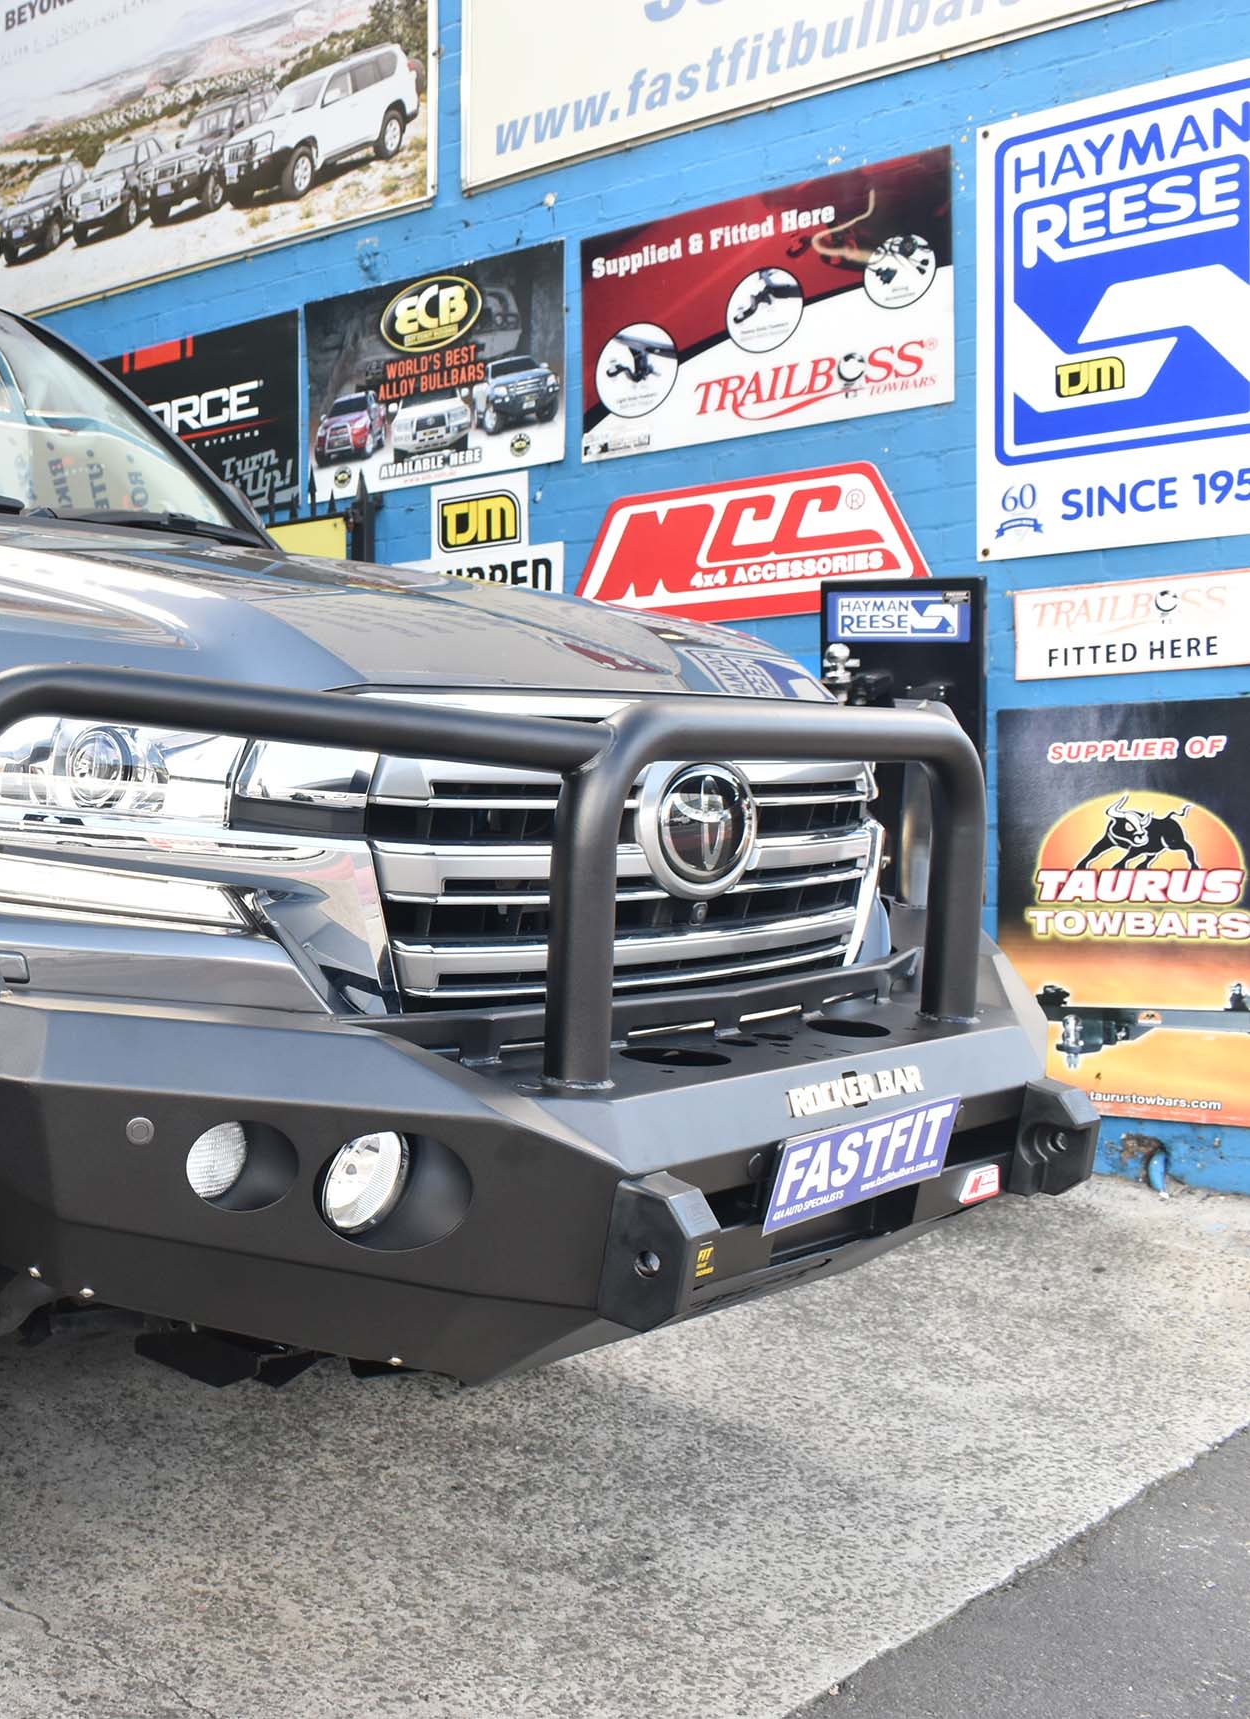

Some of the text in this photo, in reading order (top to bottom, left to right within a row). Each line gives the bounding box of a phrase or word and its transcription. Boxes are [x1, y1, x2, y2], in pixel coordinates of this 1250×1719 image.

[495, 0, 1020, 155] www.fastfitbullba
[1014, 101, 1250, 194] HAYMAN
[1022, 162, 1240, 268] REESE
[592, 205, 835, 278] Supplied & Fitted Here
[395, 284, 468, 335] ECB
[386, 344, 477, 379] WORLD'S BEST
[694, 340, 926, 415] TRAILBOSS
[378, 362, 486, 401] ALLOY BULLBARS
[869, 374, 937, 397] TOWBARS
[204, 429, 260, 448] SYSTEMS
[222, 448, 279, 481] Turn
[380, 446, 483, 479] AVAILABLE HERE
[1002, 483, 1037, 512] 60
[1061, 477, 1178, 520] SINCE
[443, 495, 516, 546] TJM
[593, 485, 875, 600] MCC
[690, 551, 884, 588] 4x4 ACCESSORIES
[840, 600, 909, 612] HAYMAN
[1032, 586, 1227, 631] TRAILBOSS
[840, 614, 909, 634] REESE
[1048, 636, 1218, 667] FITTED HERE
[1049, 736, 1226, 762] SUPPLIER OF
[1036, 869, 1244, 904] TAURUS
[1028, 909, 1250, 939] TOWBARS
[876, 1065, 925, 1098] BAR
[1088, 1091, 1222, 1110] taurustowbars.com
[776, 1103, 954, 1207] FASTFIT
[786, 1204, 804, 1216] AUTO
[803, 1190, 845, 1211] SPECIALISTS
